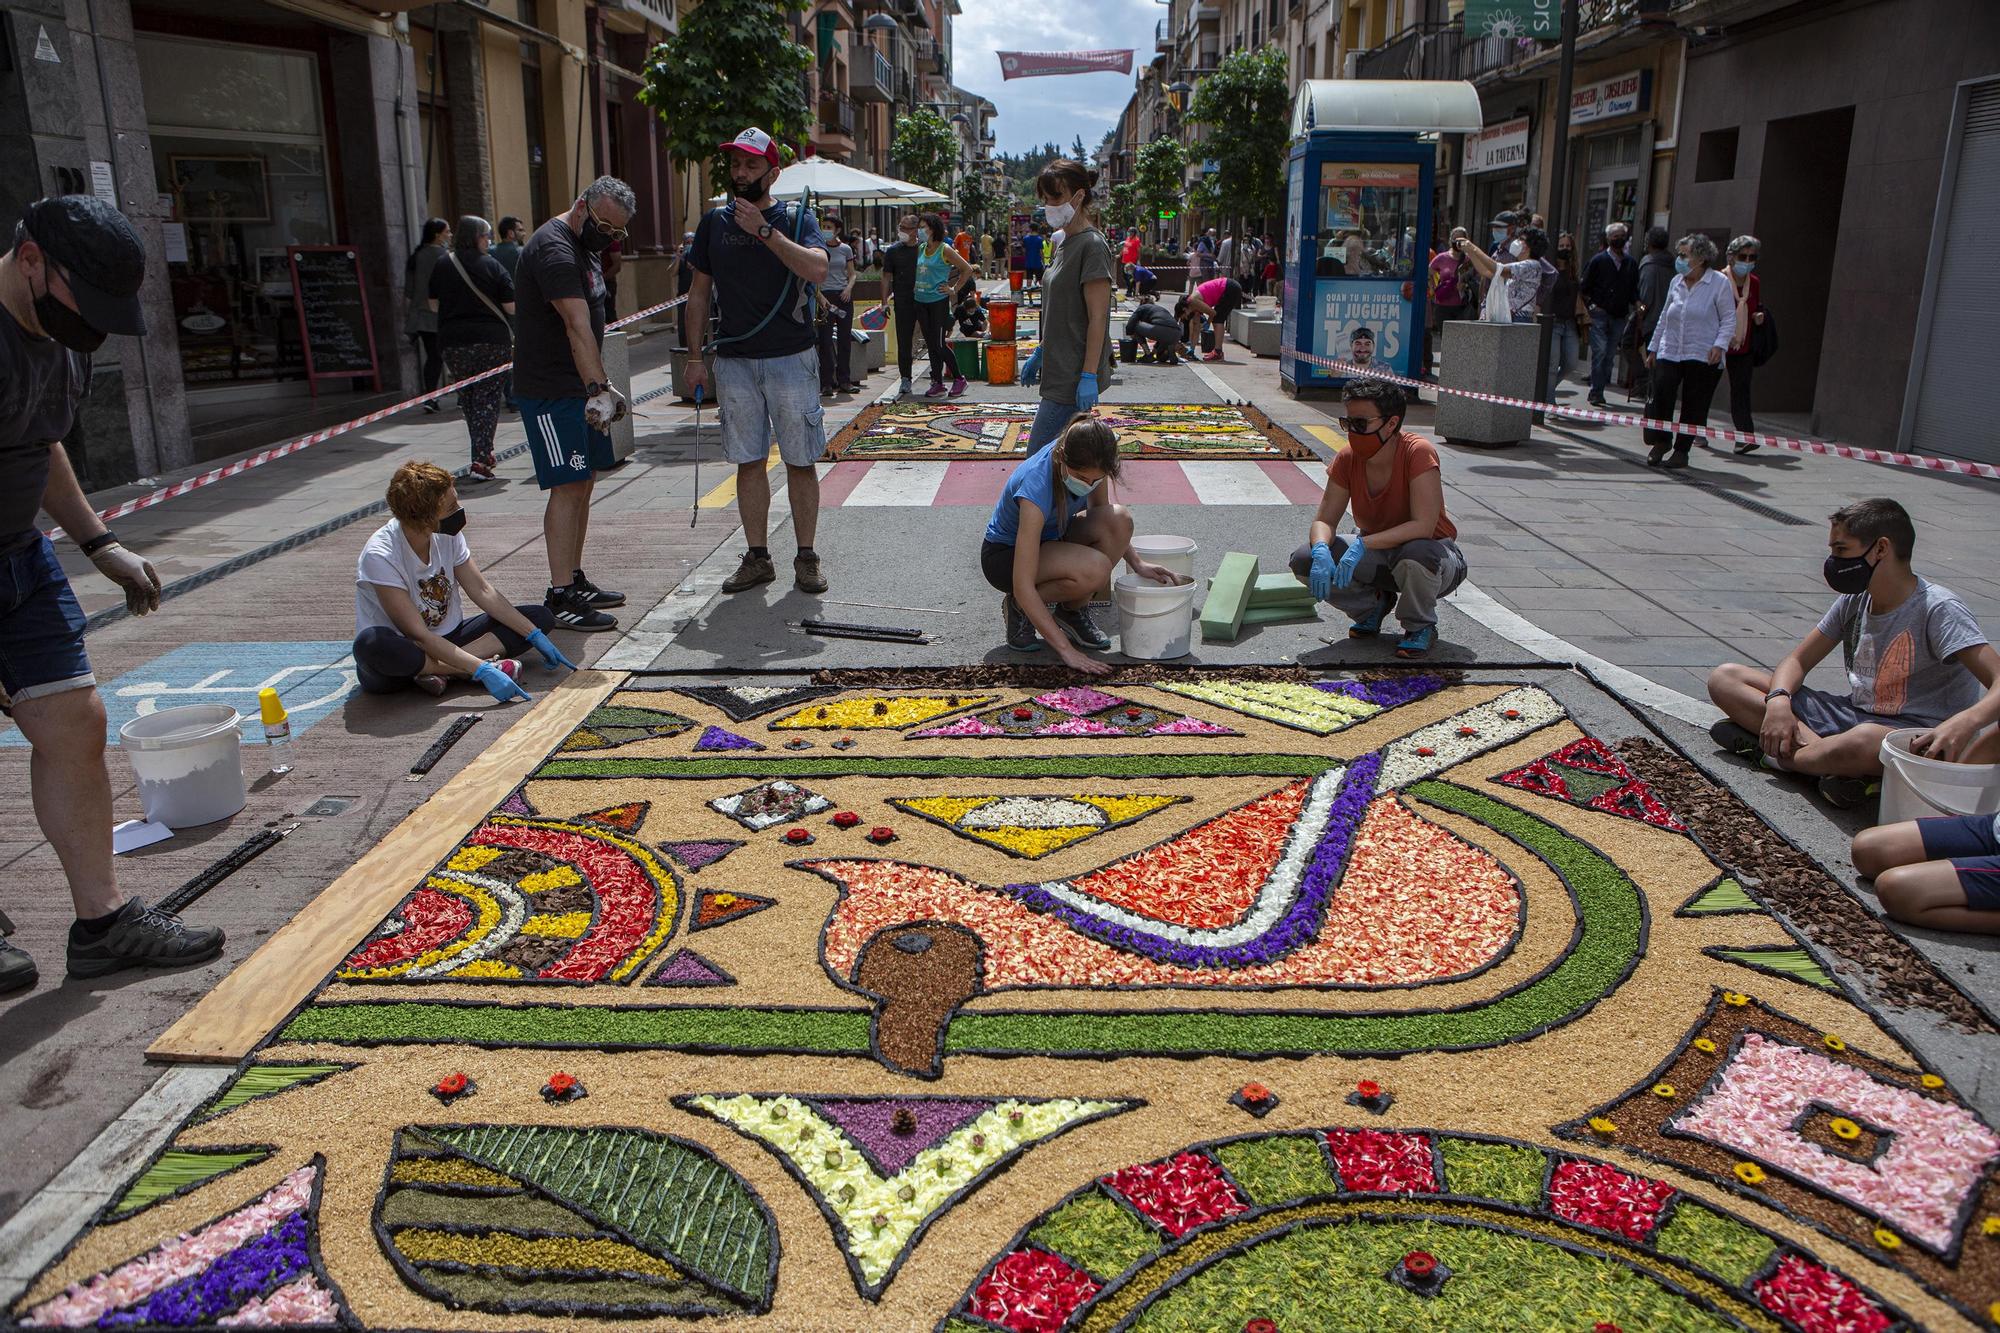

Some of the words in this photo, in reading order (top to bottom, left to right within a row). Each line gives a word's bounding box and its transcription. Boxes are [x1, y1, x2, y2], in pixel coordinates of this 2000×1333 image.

[1486, 150, 1494, 166] LA
[1496, 143, 1525, 164] TAVERNA
[1326, 293, 1347, 302] QUAN
[1350, 293, 1359, 302] TU
[1362, 294, 1370, 302] HI
[1326, 303, 1340, 319] HI
[1345, 303, 1400, 320] JUGUEM
